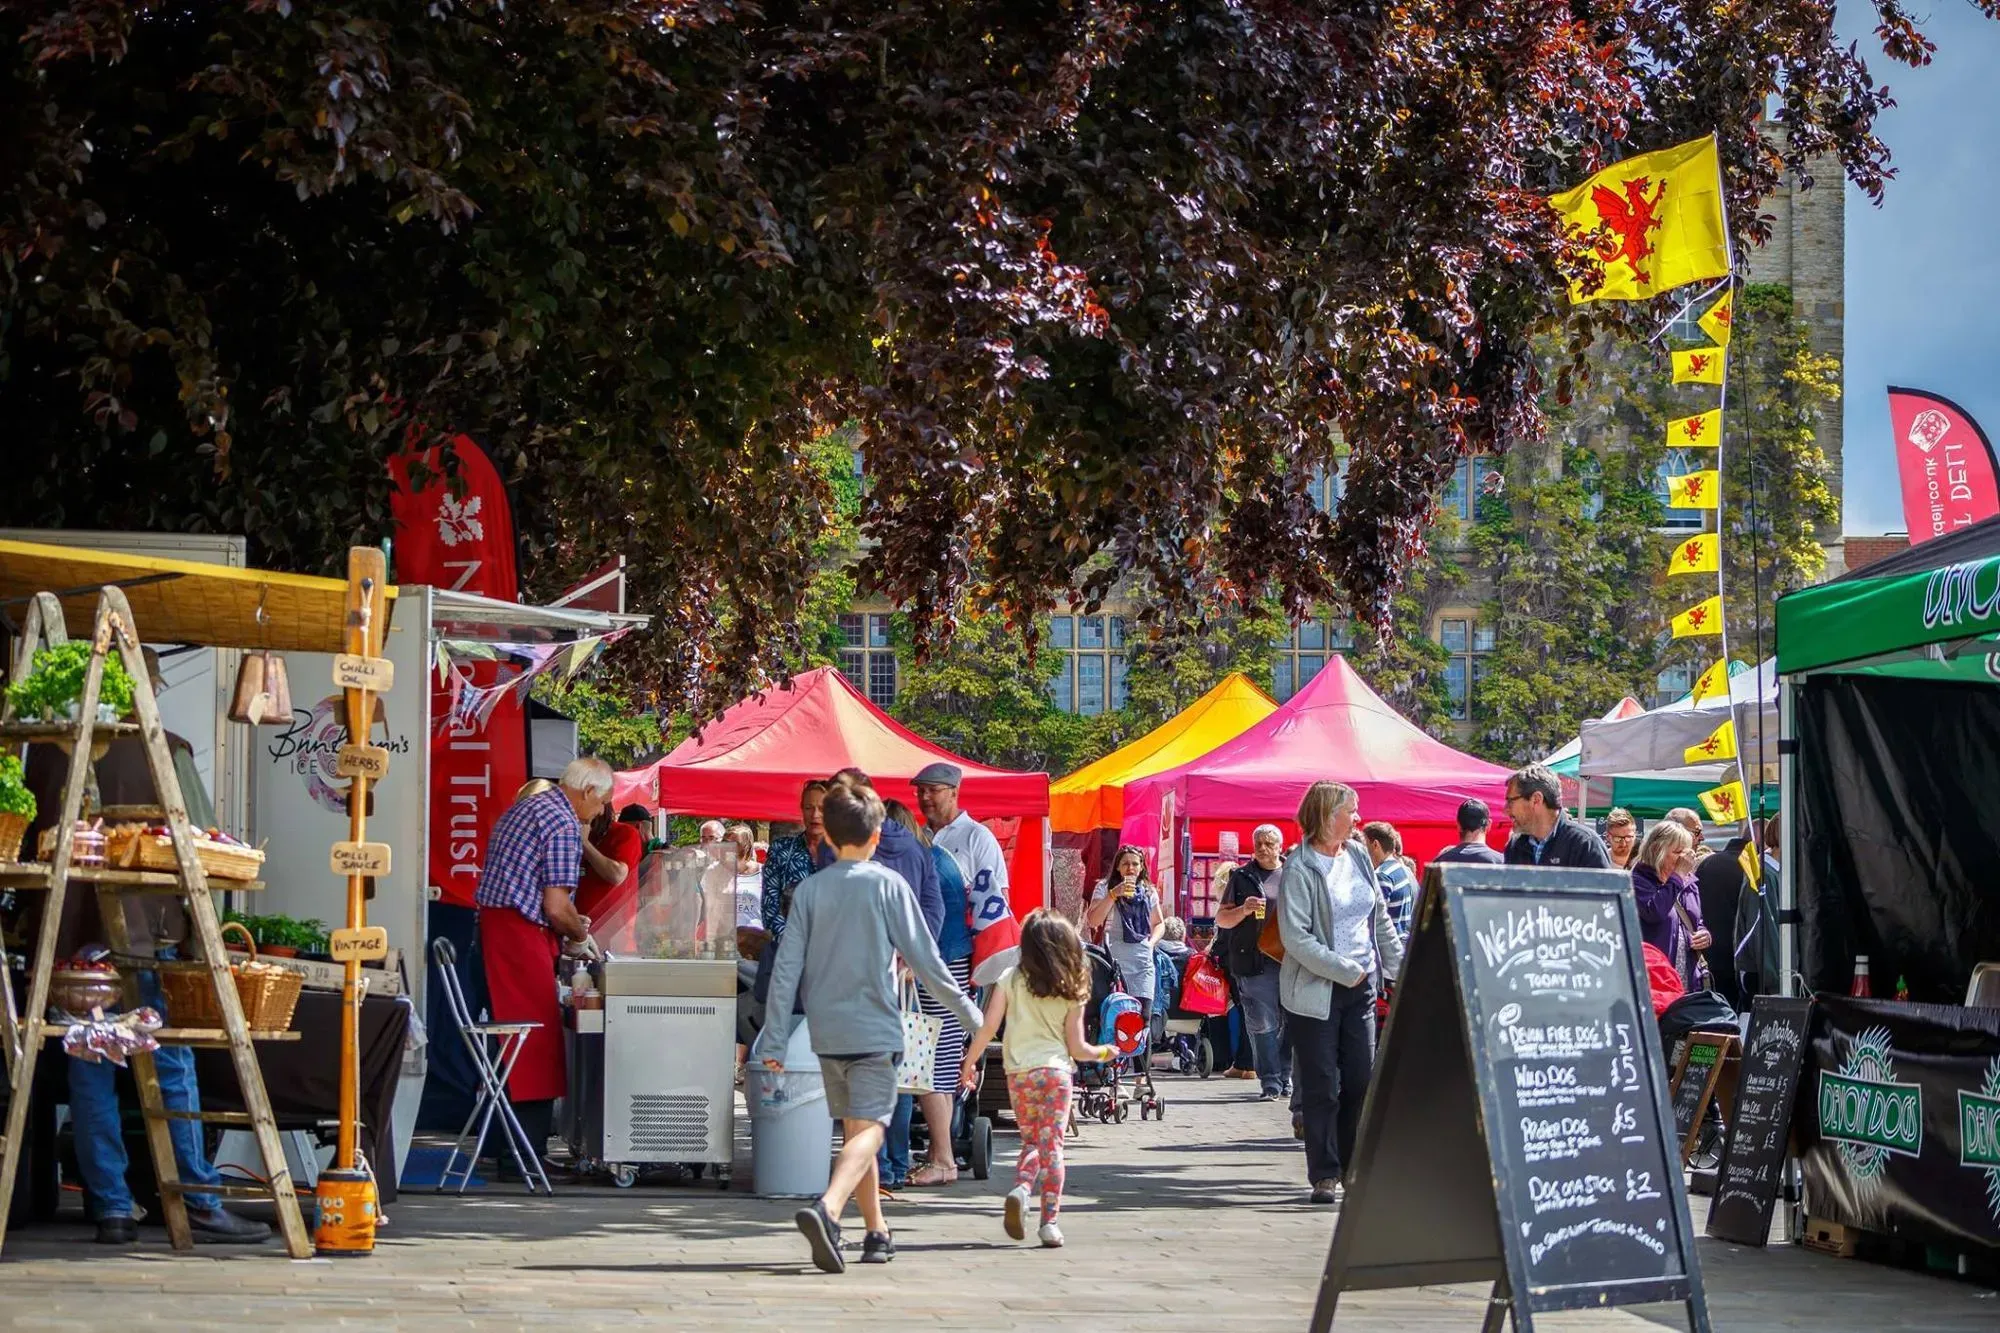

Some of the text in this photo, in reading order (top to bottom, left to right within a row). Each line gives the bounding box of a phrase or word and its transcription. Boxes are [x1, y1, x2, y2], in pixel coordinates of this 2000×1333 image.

[340, 661, 375, 676] CHILLI
[290, 760, 318, 775] ICE
[344, 754, 381, 772] HERBS
[450, 763, 491, 879] Trust
[333, 850, 369, 861] CHILLI
[341, 860, 381, 870] SAUCE
[1535, 904, 1583, 941] these
[1581, 913, 1622, 967] dogs
[334, 938, 381, 952] VINTAGE
[1536, 938, 1579, 963] OUT!
[1523, 972, 1592, 989] TODAY IT'S
[1546, 1025, 1573, 1043] FIRE
[1514, 1055, 1638, 1089] WILD DOG £5
[1560, 1117, 1590, 1137] DOG
[1611, 1102, 1637, 1136] £5
[1822, 1082, 1918, 1143] DEVON DOGS
[1528, 1175, 1561, 1201] DOG
[1625, 1168, 1653, 1202] £2
